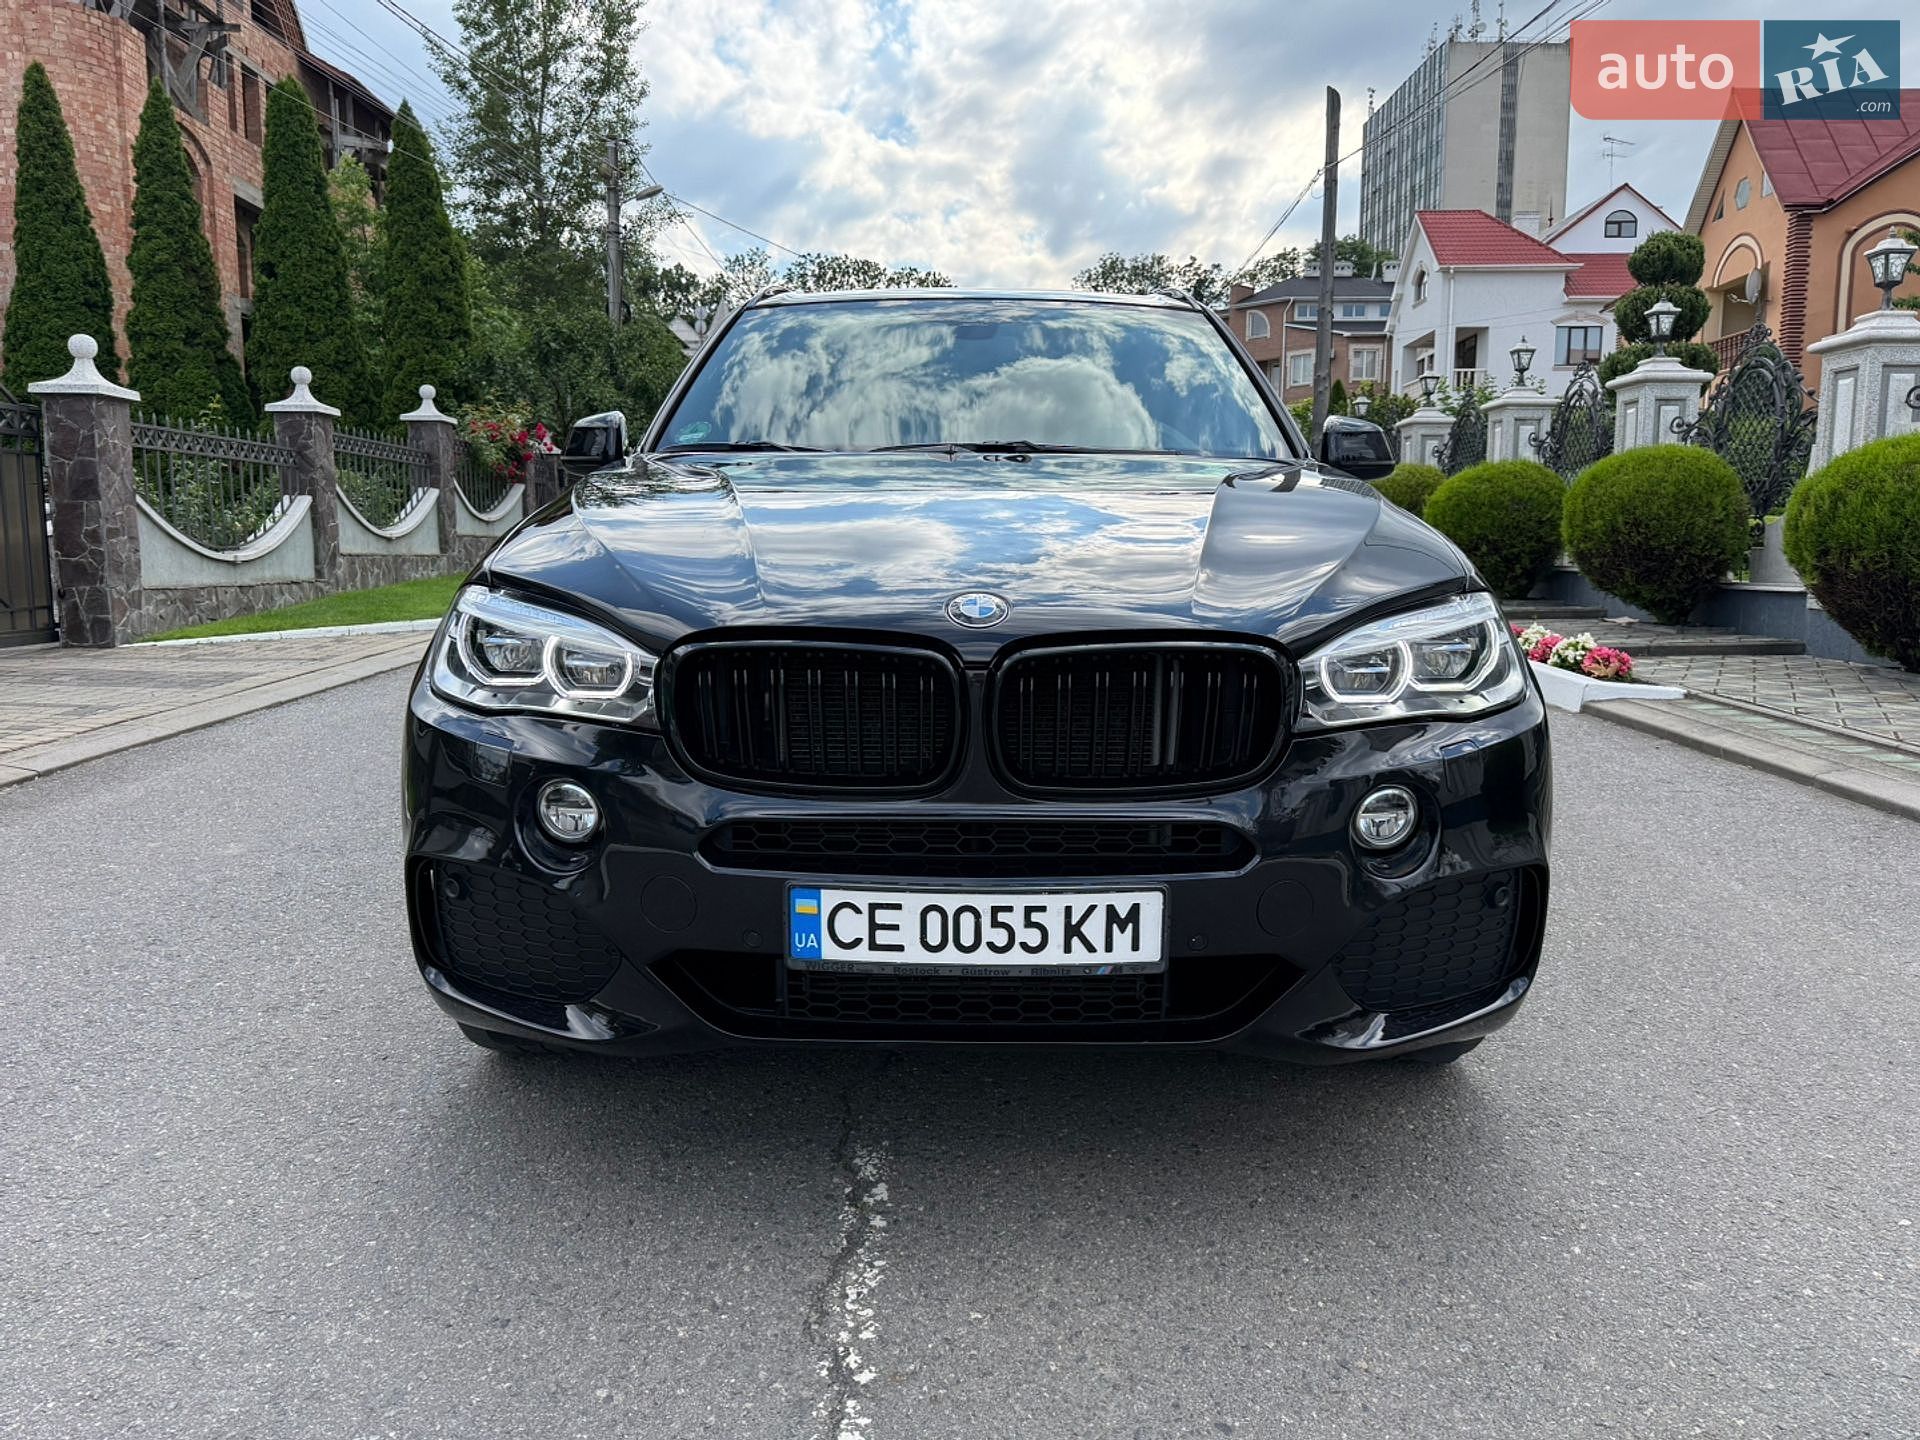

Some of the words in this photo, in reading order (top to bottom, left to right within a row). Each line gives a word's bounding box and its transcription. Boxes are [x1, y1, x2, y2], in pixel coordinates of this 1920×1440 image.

[794, 932, 819, 949] UA
[826, 901, 906, 952] CE
[919, 903, 1050, 955] 0055
[1063, 902, 1141, 955] KM
